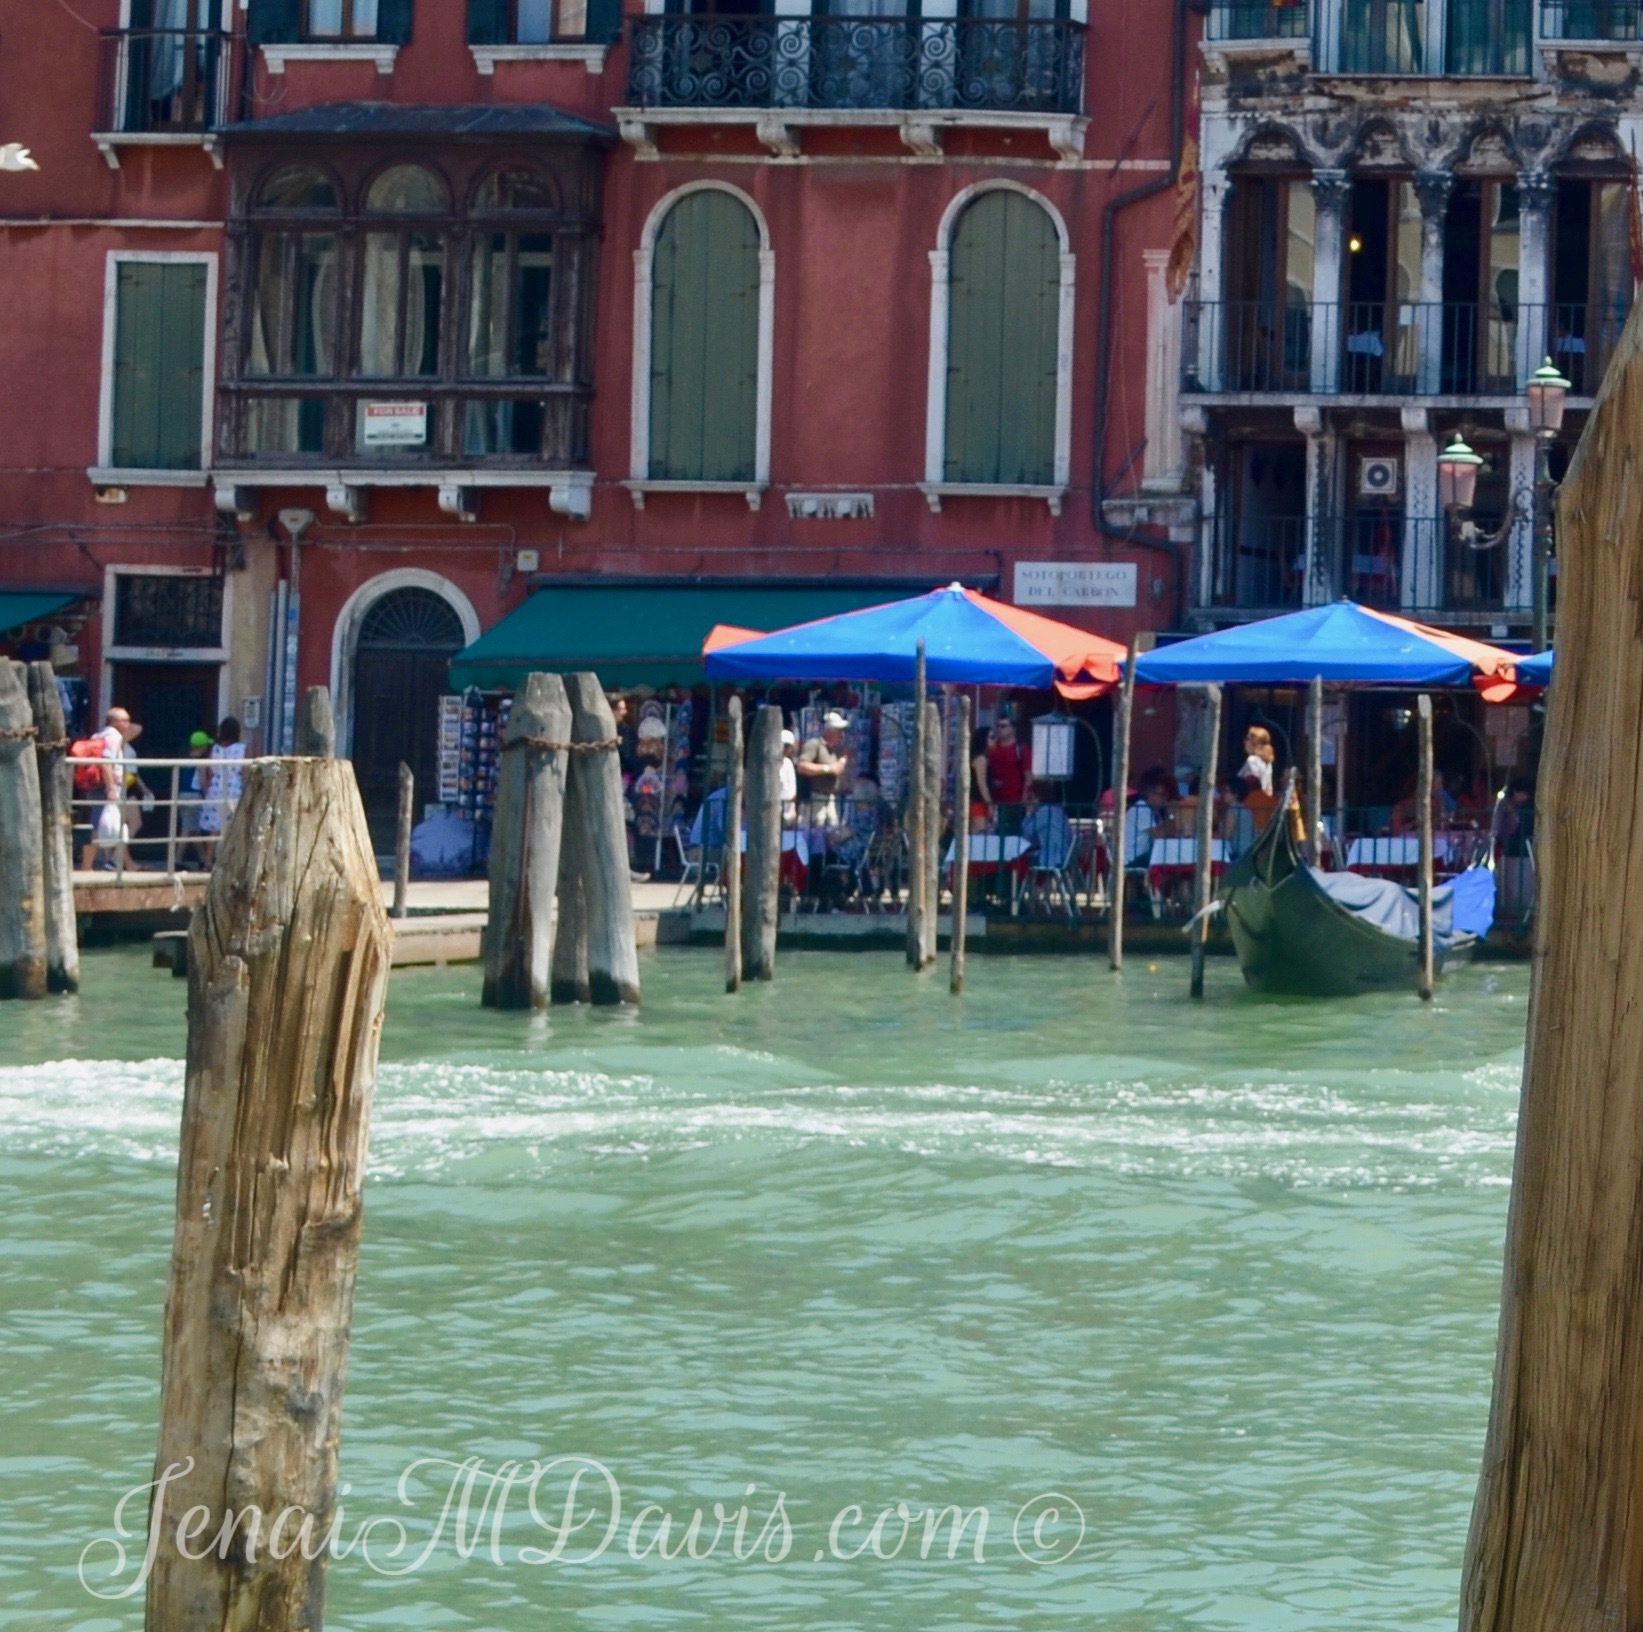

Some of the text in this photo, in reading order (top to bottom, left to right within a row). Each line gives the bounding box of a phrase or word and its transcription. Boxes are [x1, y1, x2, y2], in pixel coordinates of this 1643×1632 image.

[374, 407, 393, 416] FOR
[1028, 586, 1120, 597] DEL CARBON
